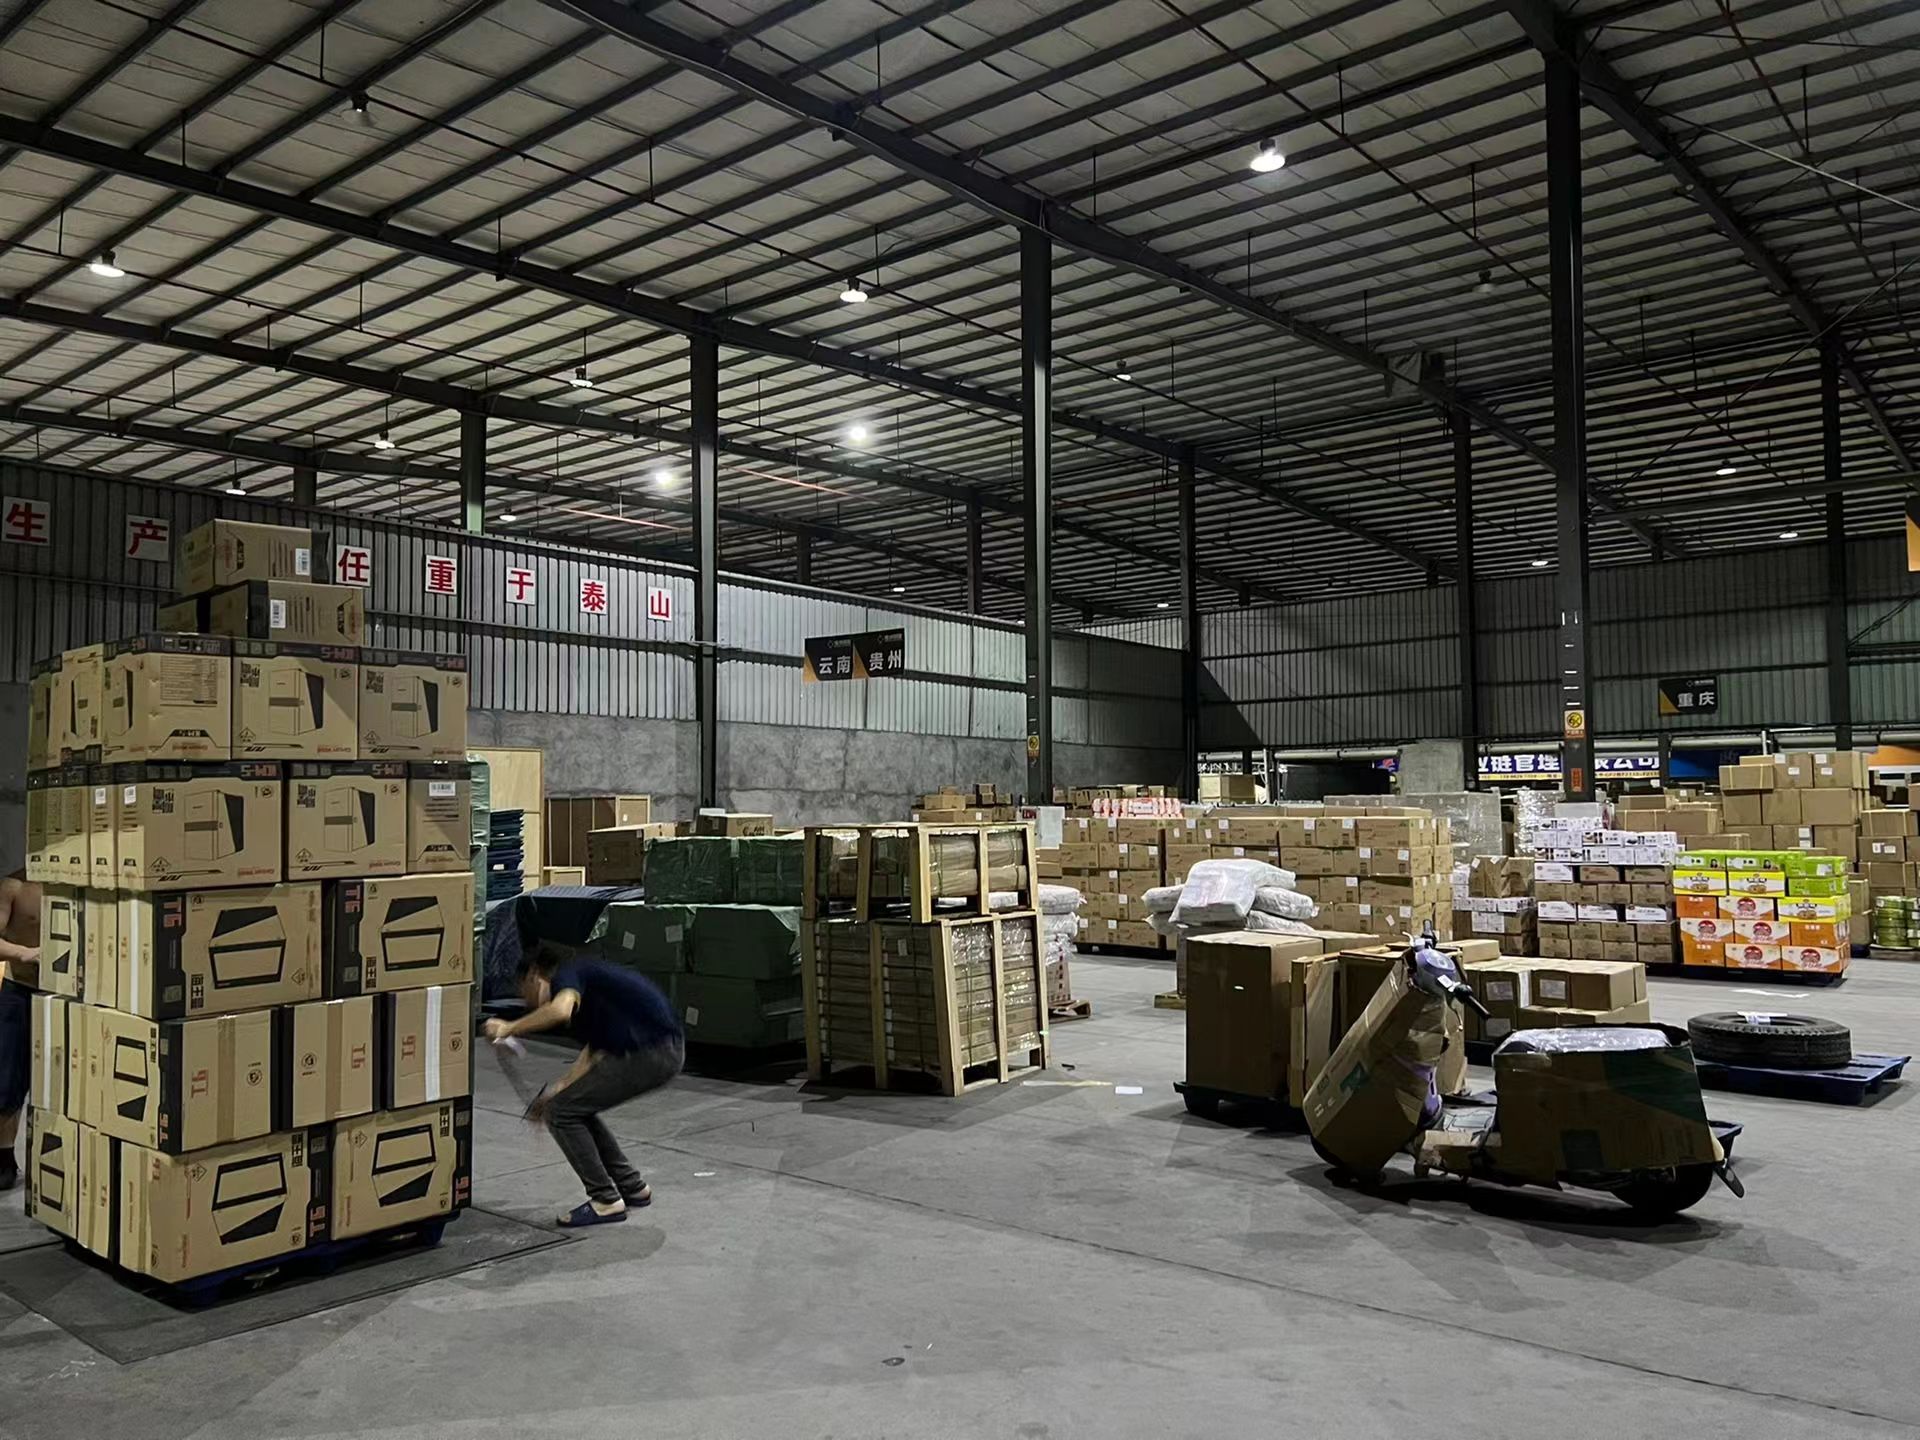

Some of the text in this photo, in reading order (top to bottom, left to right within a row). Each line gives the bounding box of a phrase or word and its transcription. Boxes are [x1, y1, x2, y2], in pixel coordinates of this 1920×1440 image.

[819, 649, 902, 674] 云南 贵州
[1677, 691, 1715, 707] 重庆
